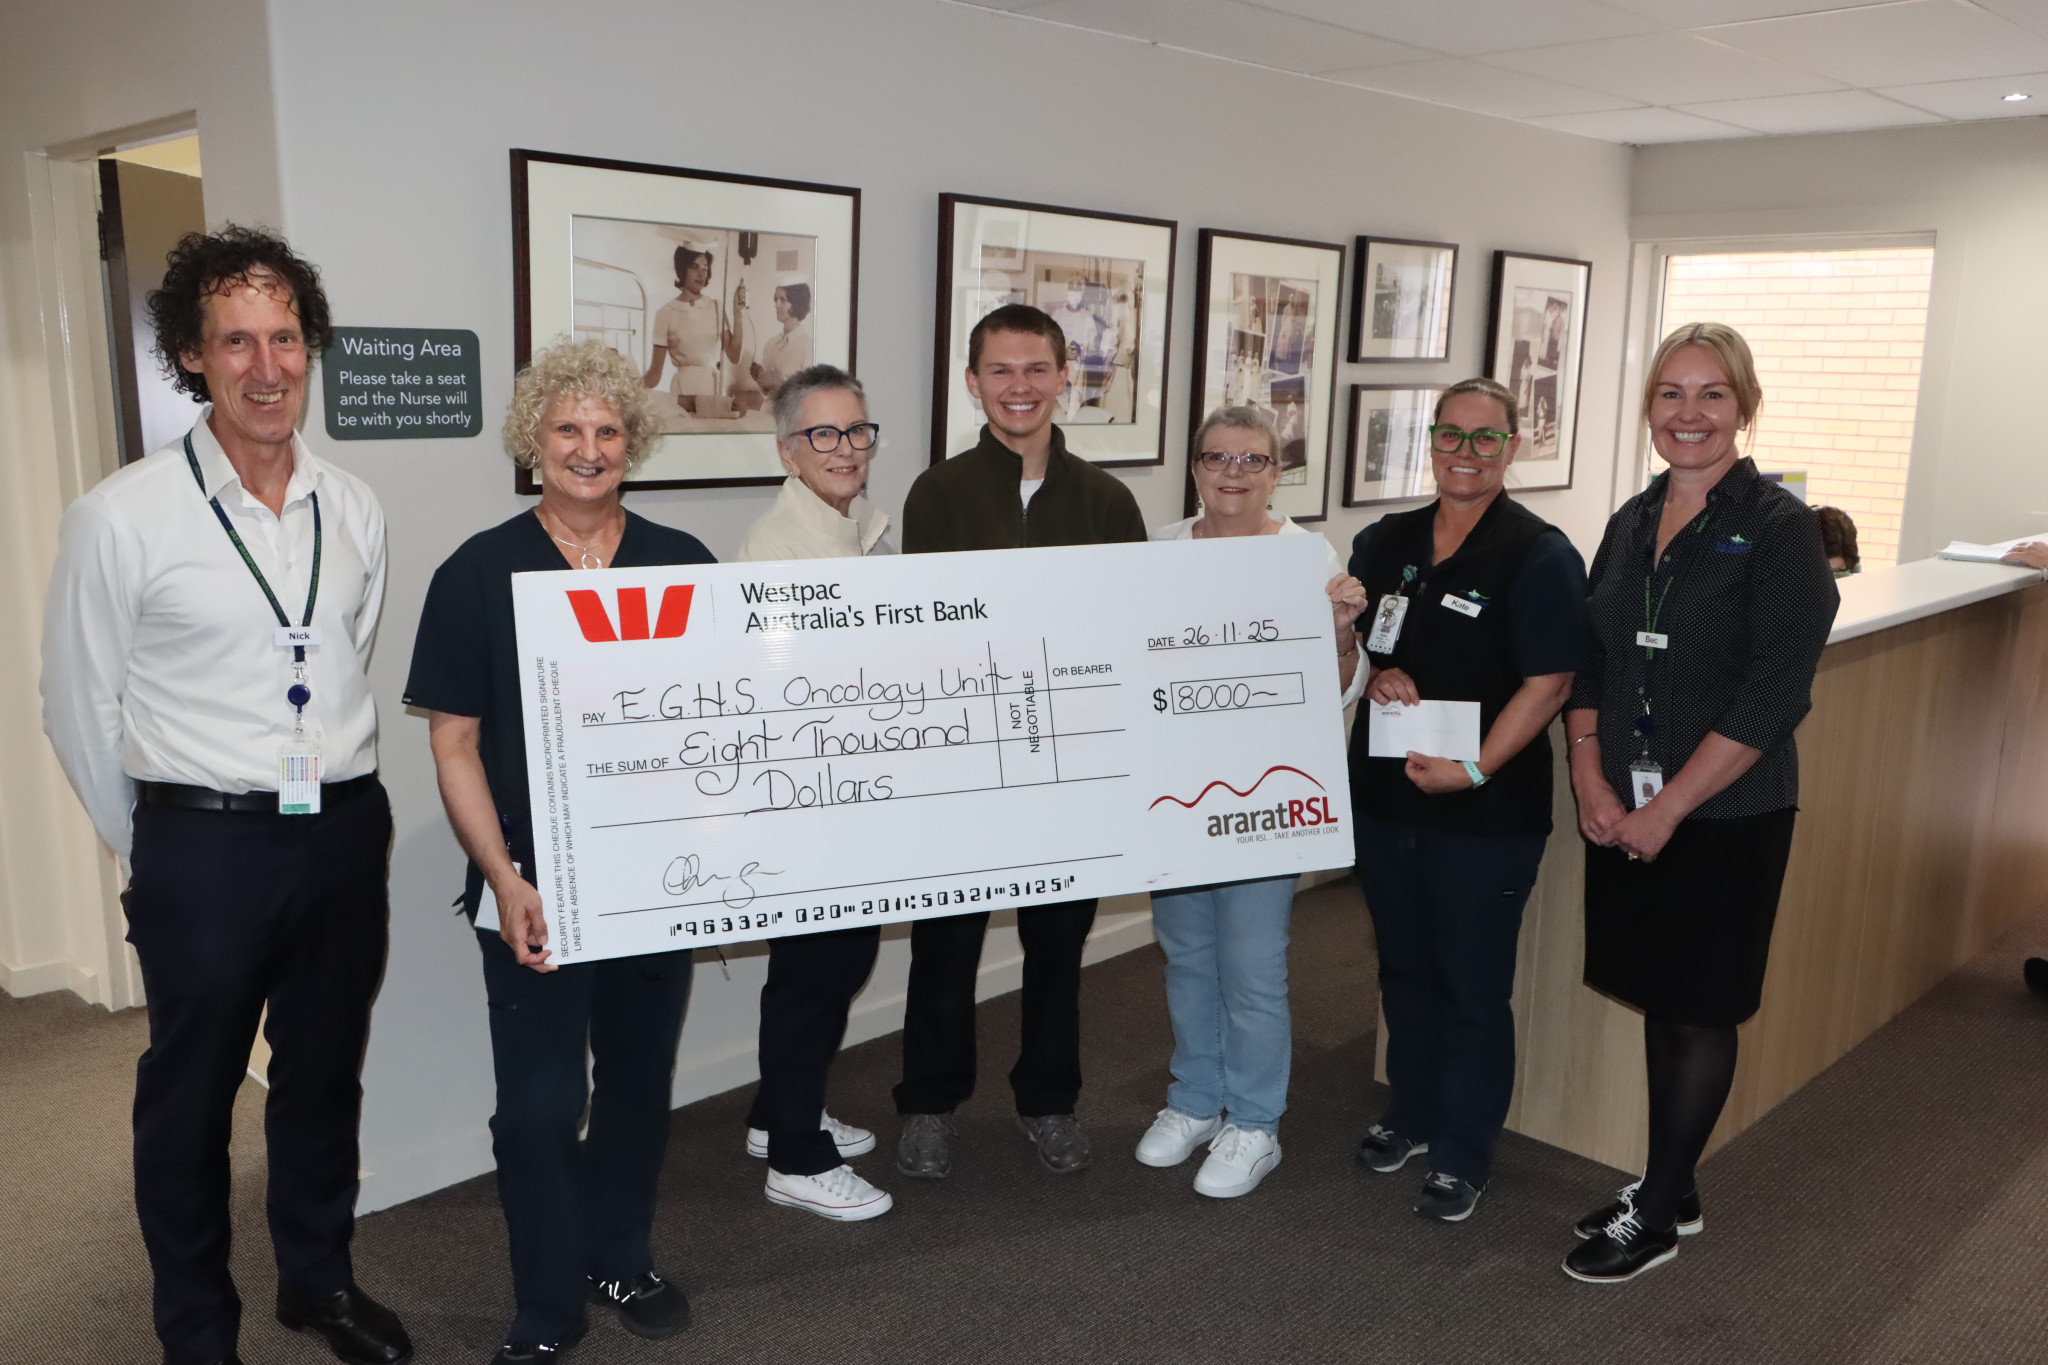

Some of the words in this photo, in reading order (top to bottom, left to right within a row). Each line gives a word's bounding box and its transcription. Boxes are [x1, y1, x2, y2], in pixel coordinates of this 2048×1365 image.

[342, 337, 414, 361] Waiting
[420, 339, 462, 357] Area
[339, 371, 387, 385] Please
[391, 371, 421, 385] take
[425, 375, 434, 385] a
[438, 373, 466, 385] seat
[340, 391, 368, 406] and
[372, 391, 396, 405] the
[400, 391, 441, 405] Nurse
[445, 391, 467, 405] will
[338, 412, 357, 426] be
[361, 411, 391, 426] with
[396, 414, 422, 429] you
[426, 411, 471, 428] shortly
[740, 582, 842, 606] Westpac
[1452, 599, 1470, 611] Kate
[745, 604, 865, 634] Australia's
[875, 603, 925, 626] First
[933, 597, 989, 622] Bank
[288, 632, 311, 640] Nick
[1147, 637, 1176, 648] DATE
[1645, 635, 1658, 645] Bec
[537, 656, 547, 704] SIGNATURE
[550, 660, 559, 696] CHEQUE
[1053, 667, 1069, 677] OR
[1071, 664, 1113, 676] BEARER
[612, 678, 764, 720] E.G.H.S.
[784, 667, 925, 721] Oncology
[940, 661, 1013, 696] Unit
[553, 698, 564, 752] FRAUDULENT
[582, 712, 607, 724] PAY
[1009, 702, 1022, 730] NOT
[1023, 670, 1041, 753] NEGOTIABLE
[541, 705, 553, 769] MICROPRINTED
[679, 719, 783, 796] Eight
[793, 707, 970, 757] Thousand
[586, 763, 613, 775] THE
[617, 760, 647, 773] SUM
[651, 757, 669, 769] OF
[546, 771, 558, 814] CONTAINS
[558, 763, 568, 801] INDICATE
[745, 763, 893, 815] Dollars
[562, 803, 570, 820] MAY
[1207, 796, 1339, 837] araratRSL
[550, 816, 561, 852] CHEQUE
[564, 821, 573, 851] WHICH
[1235, 834, 1254, 844] YOUR
[1256, 833, 1267, 842] RSL
[1274, 830, 1290, 840] TAKE
[1292, 828, 1321, 838] ANOTHER
[1323, 825, 1340, 835] LOOK
[553, 853, 562, 873] THIS
[566, 852, 574, 865] OF
[555, 874, 565, 913] FEATURE
[567, 866, 577, 906] ABSENCE
[570, 908, 579, 926] THE
[558, 915, 569, 958] SECURITY
[573, 926, 582, 952] LINES
